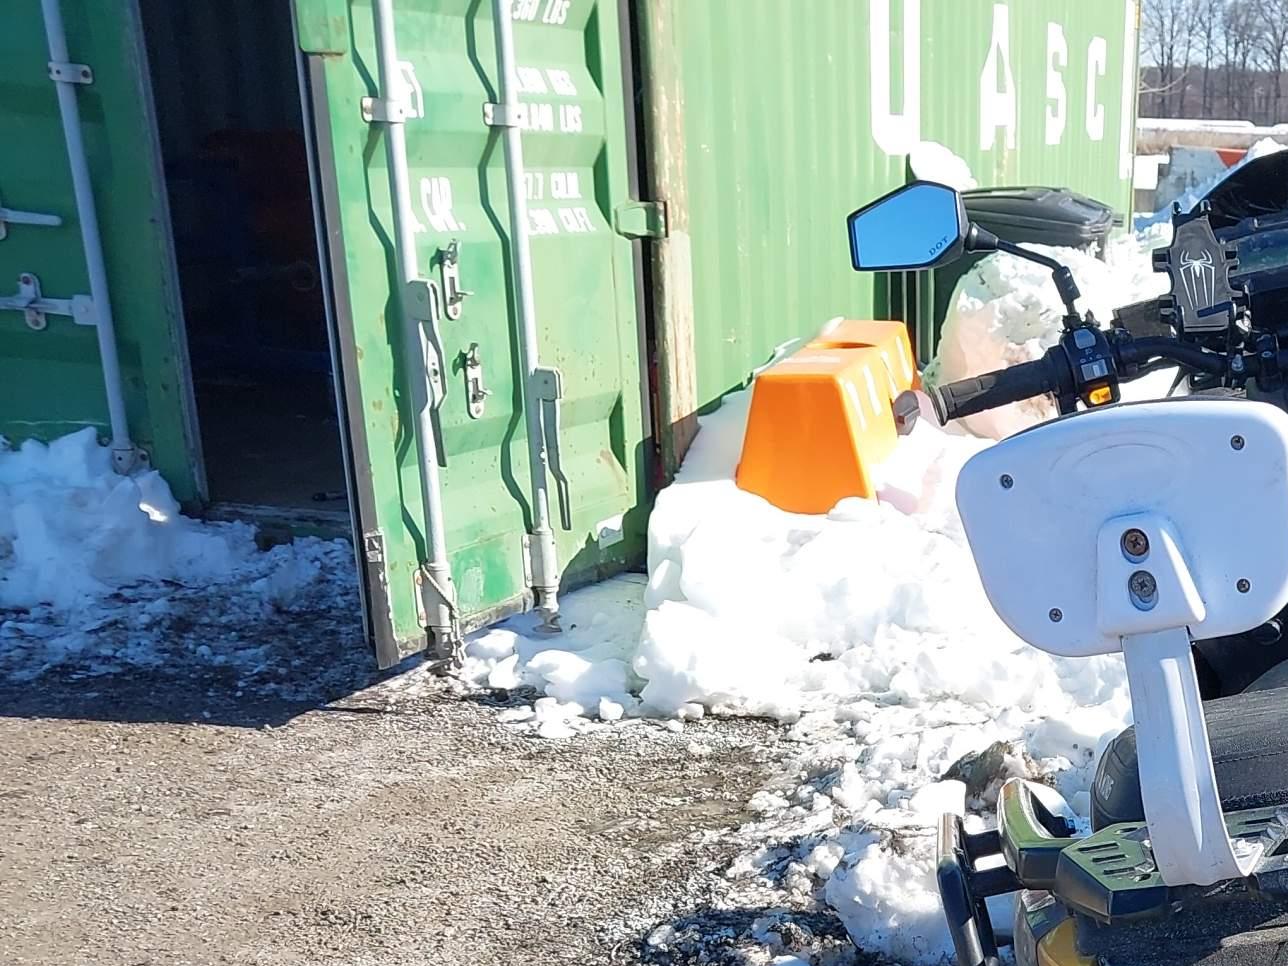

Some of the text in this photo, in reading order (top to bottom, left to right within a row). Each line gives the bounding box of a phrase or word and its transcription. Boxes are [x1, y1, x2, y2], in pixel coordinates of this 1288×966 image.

[542, 0, 571, 24] LBS
[560, 104, 582, 132] LBS
[928, 235, 948, 256] DOT
